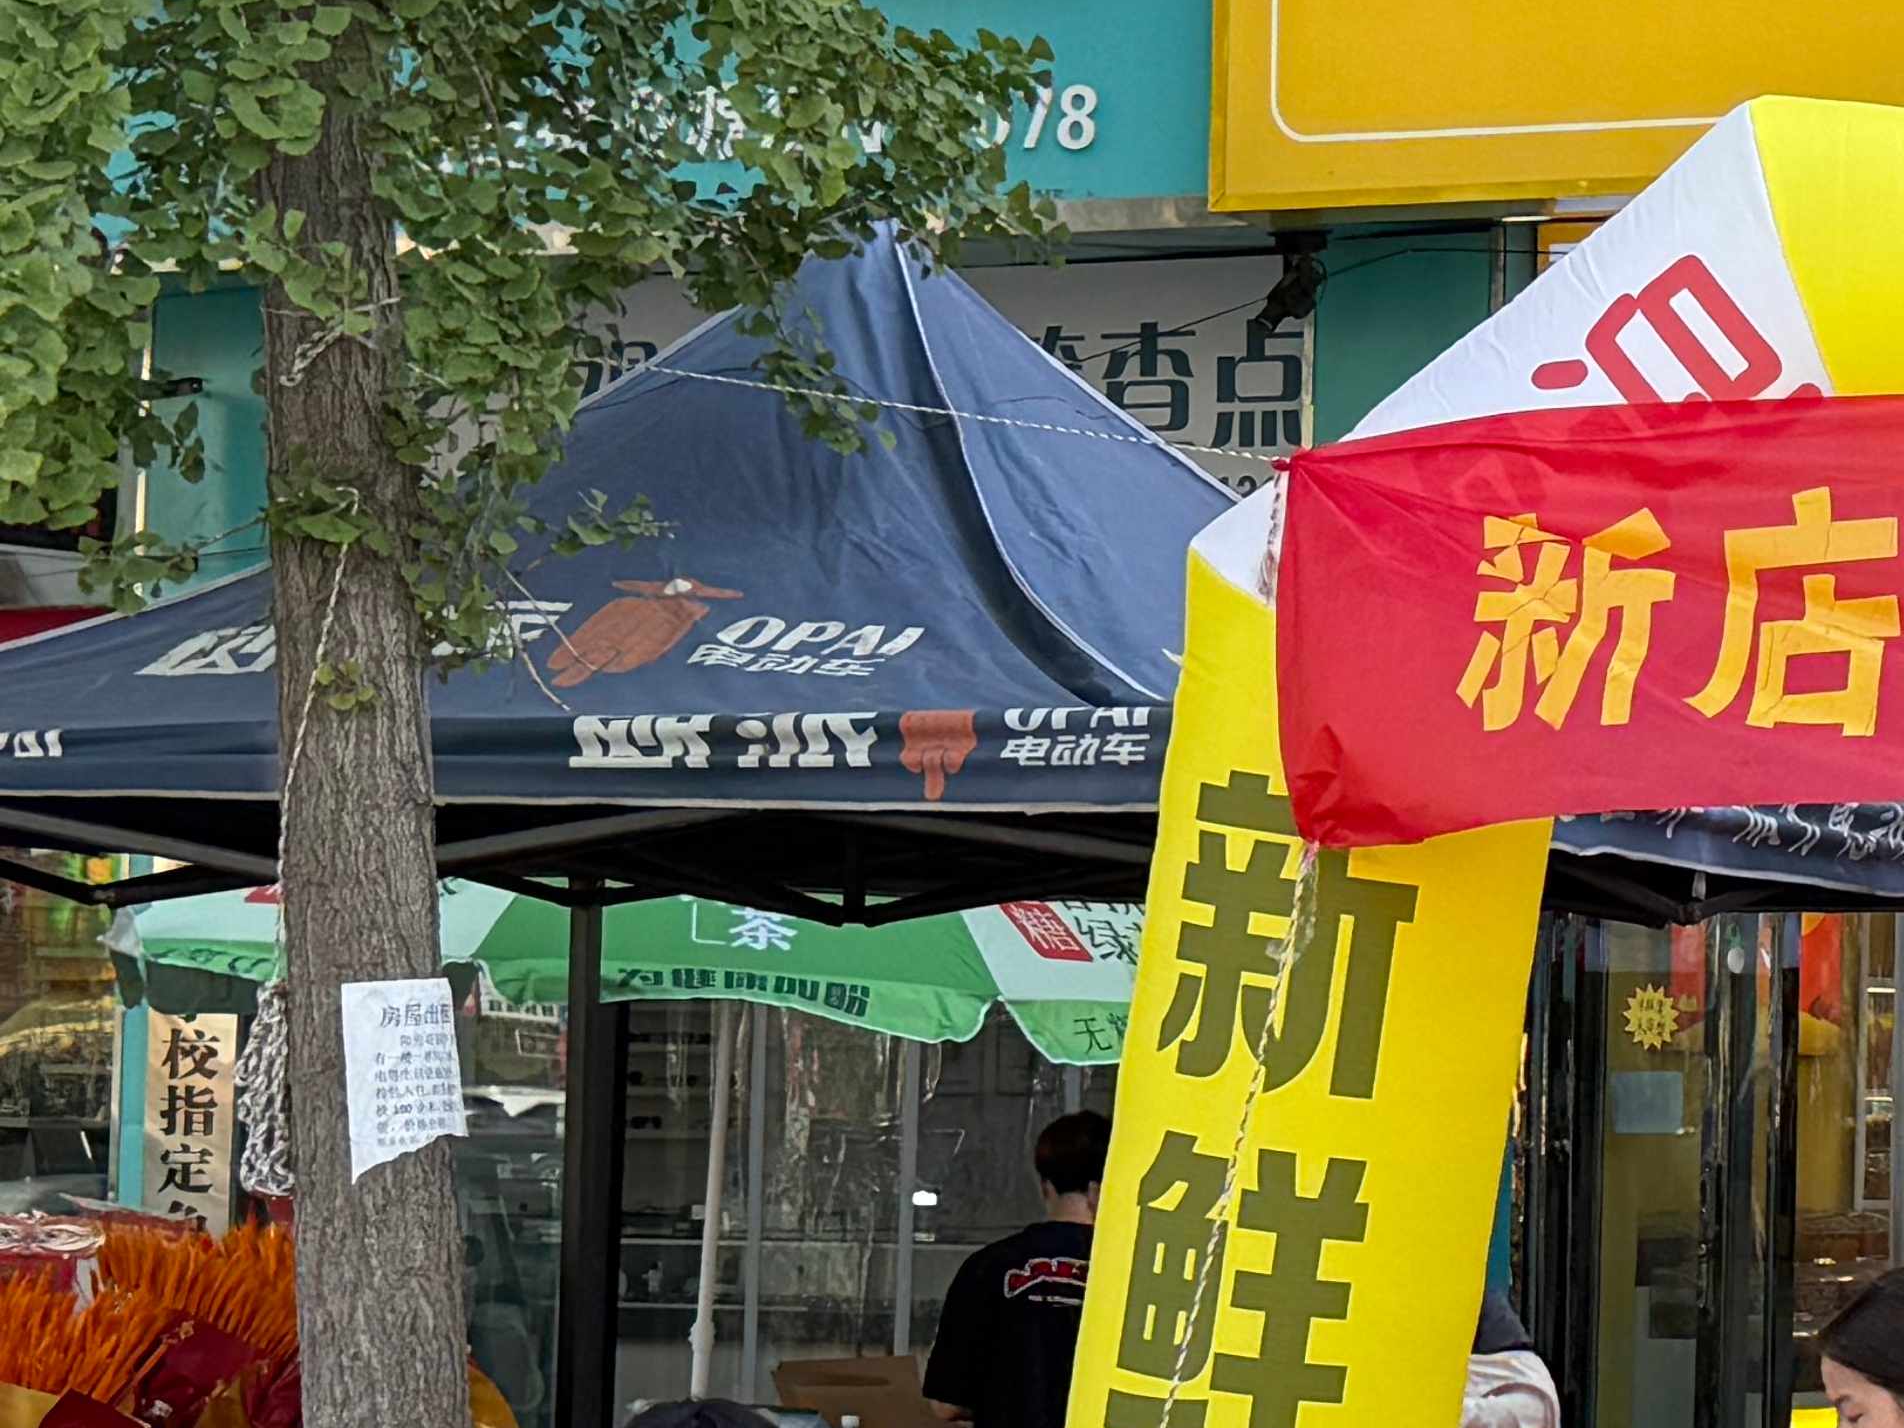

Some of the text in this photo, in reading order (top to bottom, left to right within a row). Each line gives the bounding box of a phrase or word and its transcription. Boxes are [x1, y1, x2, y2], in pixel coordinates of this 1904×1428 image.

[716, 616, 926, 658] OPAI
[1000, 734, 1152, 767] 电动车
